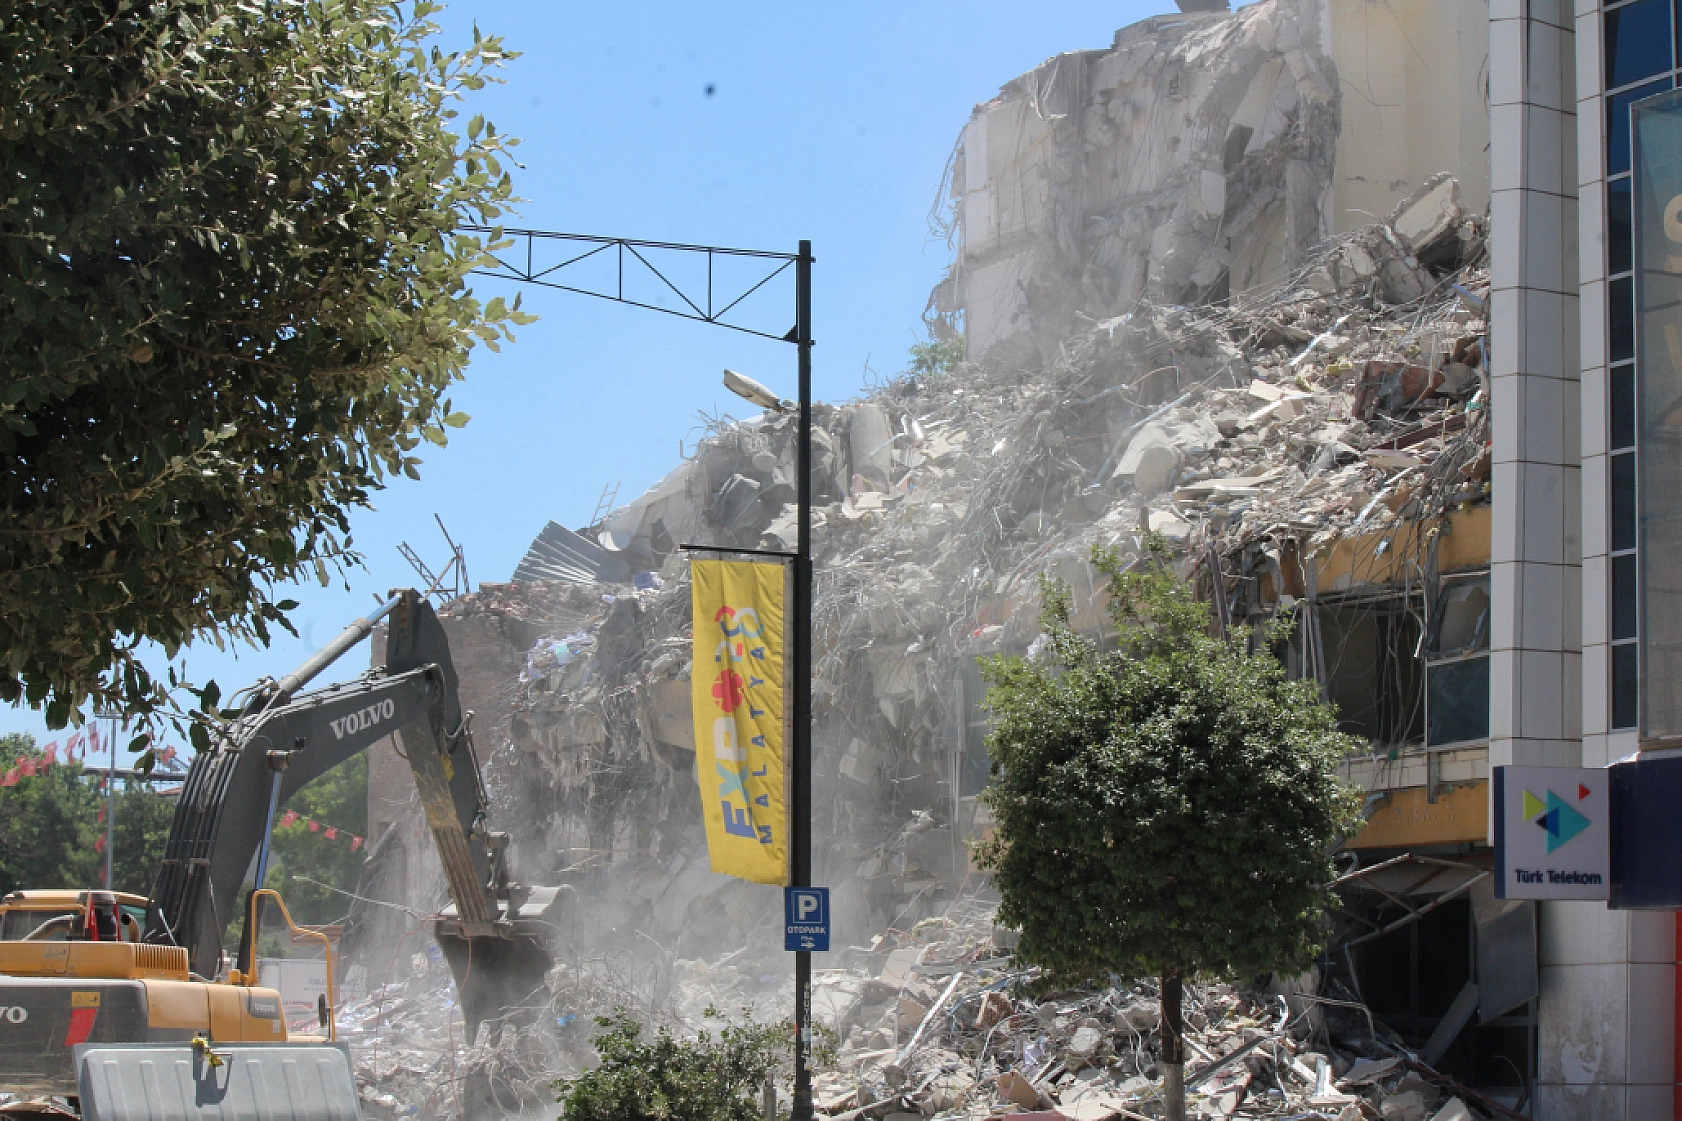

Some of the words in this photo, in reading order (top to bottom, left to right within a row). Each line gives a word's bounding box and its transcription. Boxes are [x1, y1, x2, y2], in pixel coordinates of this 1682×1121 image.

[330, 699, 395, 740] VOLVO
[750, 646, 773, 844] MALATYA
[1515, 868, 1543, 883] Türk
[1546, 868, 1602, 885] Telekom
[798, 895, 818, 921] P
[787, 926, 826, 934] OTOPARK
